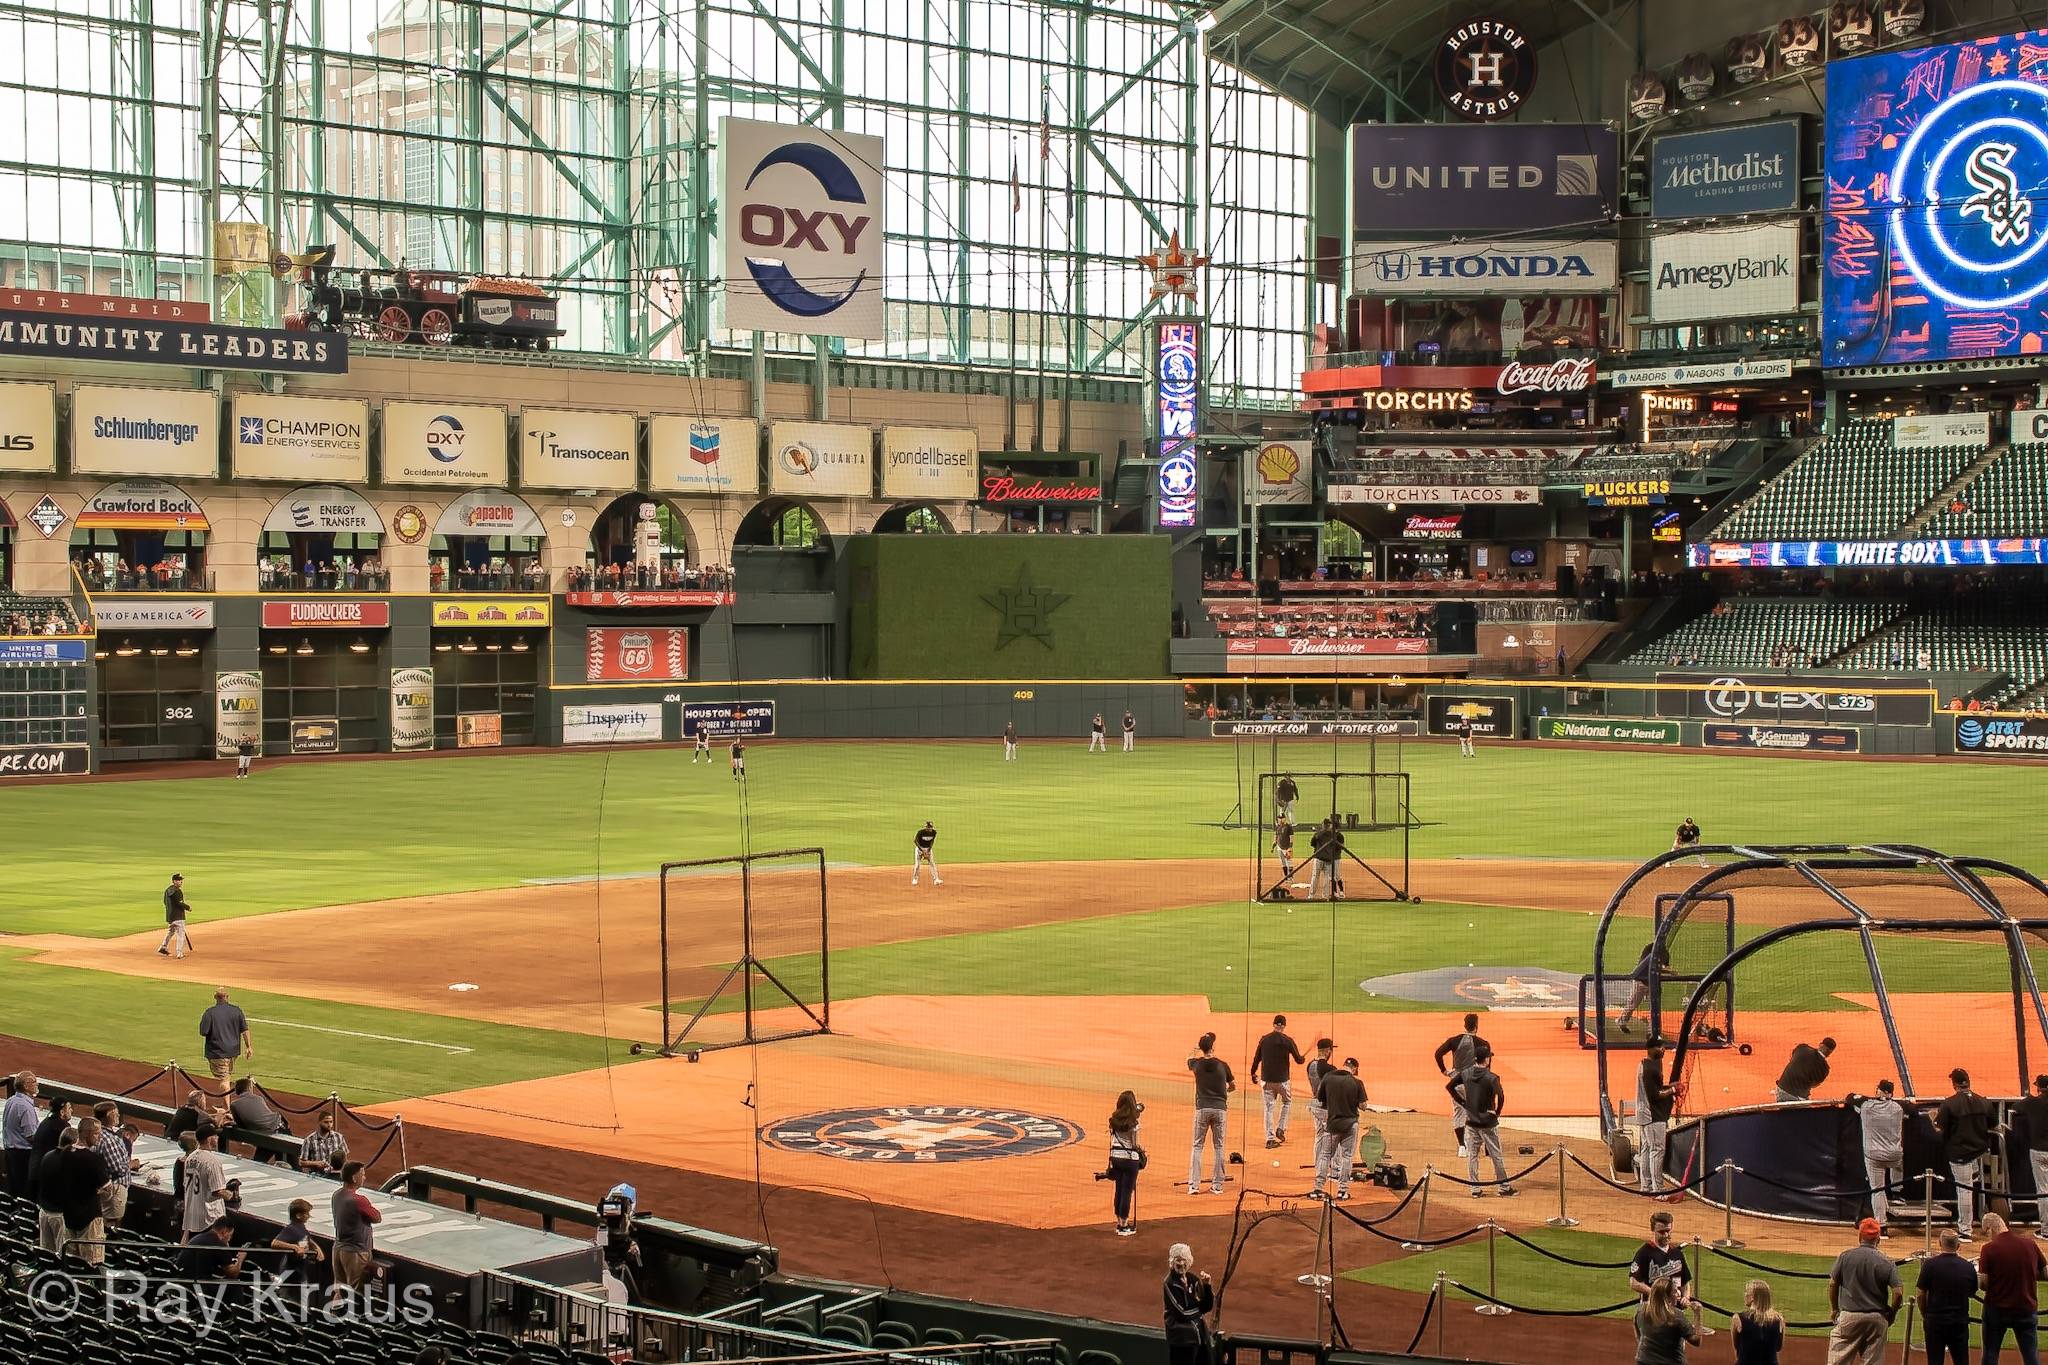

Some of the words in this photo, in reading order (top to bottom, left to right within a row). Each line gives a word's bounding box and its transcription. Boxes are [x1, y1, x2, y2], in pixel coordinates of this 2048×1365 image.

[1886, 18, 1921, 32] ROBINSON
[1447, 21, 1525, 51] HOUSTON
[1785, 50, 1807, 59] SCOTT
[1468, 53, 1504, 87] H
[1450, 91, 1520, 115] ASTROS
[1662, 153, 1710, 166] HOUSTON
[1661, 151, 1784, 189] Methodist
[1371, 165, 1544, 190] UNITED
[1694, 186, 1735, 198] LEADING
[1738, 180, 1785, 193] MEDICINE
[741, 203, 871, 255] OXY
[228, 233, 260, 259] 17
[1417, 255, 1595, 278] HONDA
[1656, 252, 1790, 290] AmegyBank
[102, 301, 181, 318] MAID
[180, 332, 328, 363] LEADERS
[1686, 368, 1726, 379] NABORS
[1745, 364, 1786, 375] NABORS
[1629, 371, 1668, 382] NABORS
[1363, 390, 1473, 411] TORCHYS
[266, 418, 360, 438] CHAMPION
[689, 423, 720, 432] Chevron
[1162, 410, 1194, 436] VS
[94, 415, 199, 446] Schlumberger
[266, 437, 309, 448] ENERGY
[310, 438, 361, 450] SERVICES
[426, 432, 466, 445] OXY
[549, 443, 630, 462] Transocean
[823, 452, 865, 465] QUANTA
[888, 445, 973, 467] lyondellbasell
[403, 468, 447, 478] Occidental
[448, 469, 489, 478] Petroleum
[677, 474, 703, 483] human
[705, 476, 732, 485] energy
[983, 475, 1101, 501] Budweiser
[1364, 488, 1440, 501] TORCHYS
[1451, 488, 1503, 501] TACOS
[1584, 480, 1670, 497] PLUCKERS
[93, 498, 157, 513] Crawford
[159, 498, 192, 513] Bock
[1605, 496, 1630, 505] WING
[1631, 496, 1649, 505] BAR
[320, 505, 356, 516] ENERGY
[475, 505, 514, 522] apache
[320, 517, 367, 528] TRANSFER
[562, 513, 575, 523] DK
[1406, 517, 1457, 530] Budweiser
[1403, 529, 1429, 539] BREW
[1431, 529, 1463, 539] HOUSE
[1836, 542, 1898, 565] WHITE
[1900, 541, 1937, 564] SOX
[119, 612, 130, 621] OF
[132, 612, 183, 621] AMERICA
[290, 603, 362, 621] FUDDRUCKERS
[624, 637, 649, 647] PHILLIPS
[1289, 638, 1365, 655] Budweiser
[625, 650, 646, 665] 66
[396, 694, 430, 706] WM
[664, 693, 681, 702] 404
[1014, 690, 1034, 699] 409
[220, 698, 258, 711] WM
[1838, 696, 1866, 708] 373
[165, 706, 194, 719] 362
[586, 709, 648, 729] Insperity
[685, 709, 732, 719] HOUSTON
[746, 707, 772, 717] OPEN
[730, 719, 753, 728] OCTOBER
[1232, 723, 1309, 735] NITTOTIRE.COM
[1445, 722, 1495, 732] CHEROLET
[1984, 721, 2025, 735] AT&T
[1565, 722, 1609, 738] National
[1613, 727, 1631, 738] Car
[1632, 728, 1665, 740] Rental
[1766, 730, 1811, 742] Germania
[1984, 735, 2048, 750] SPORTS
